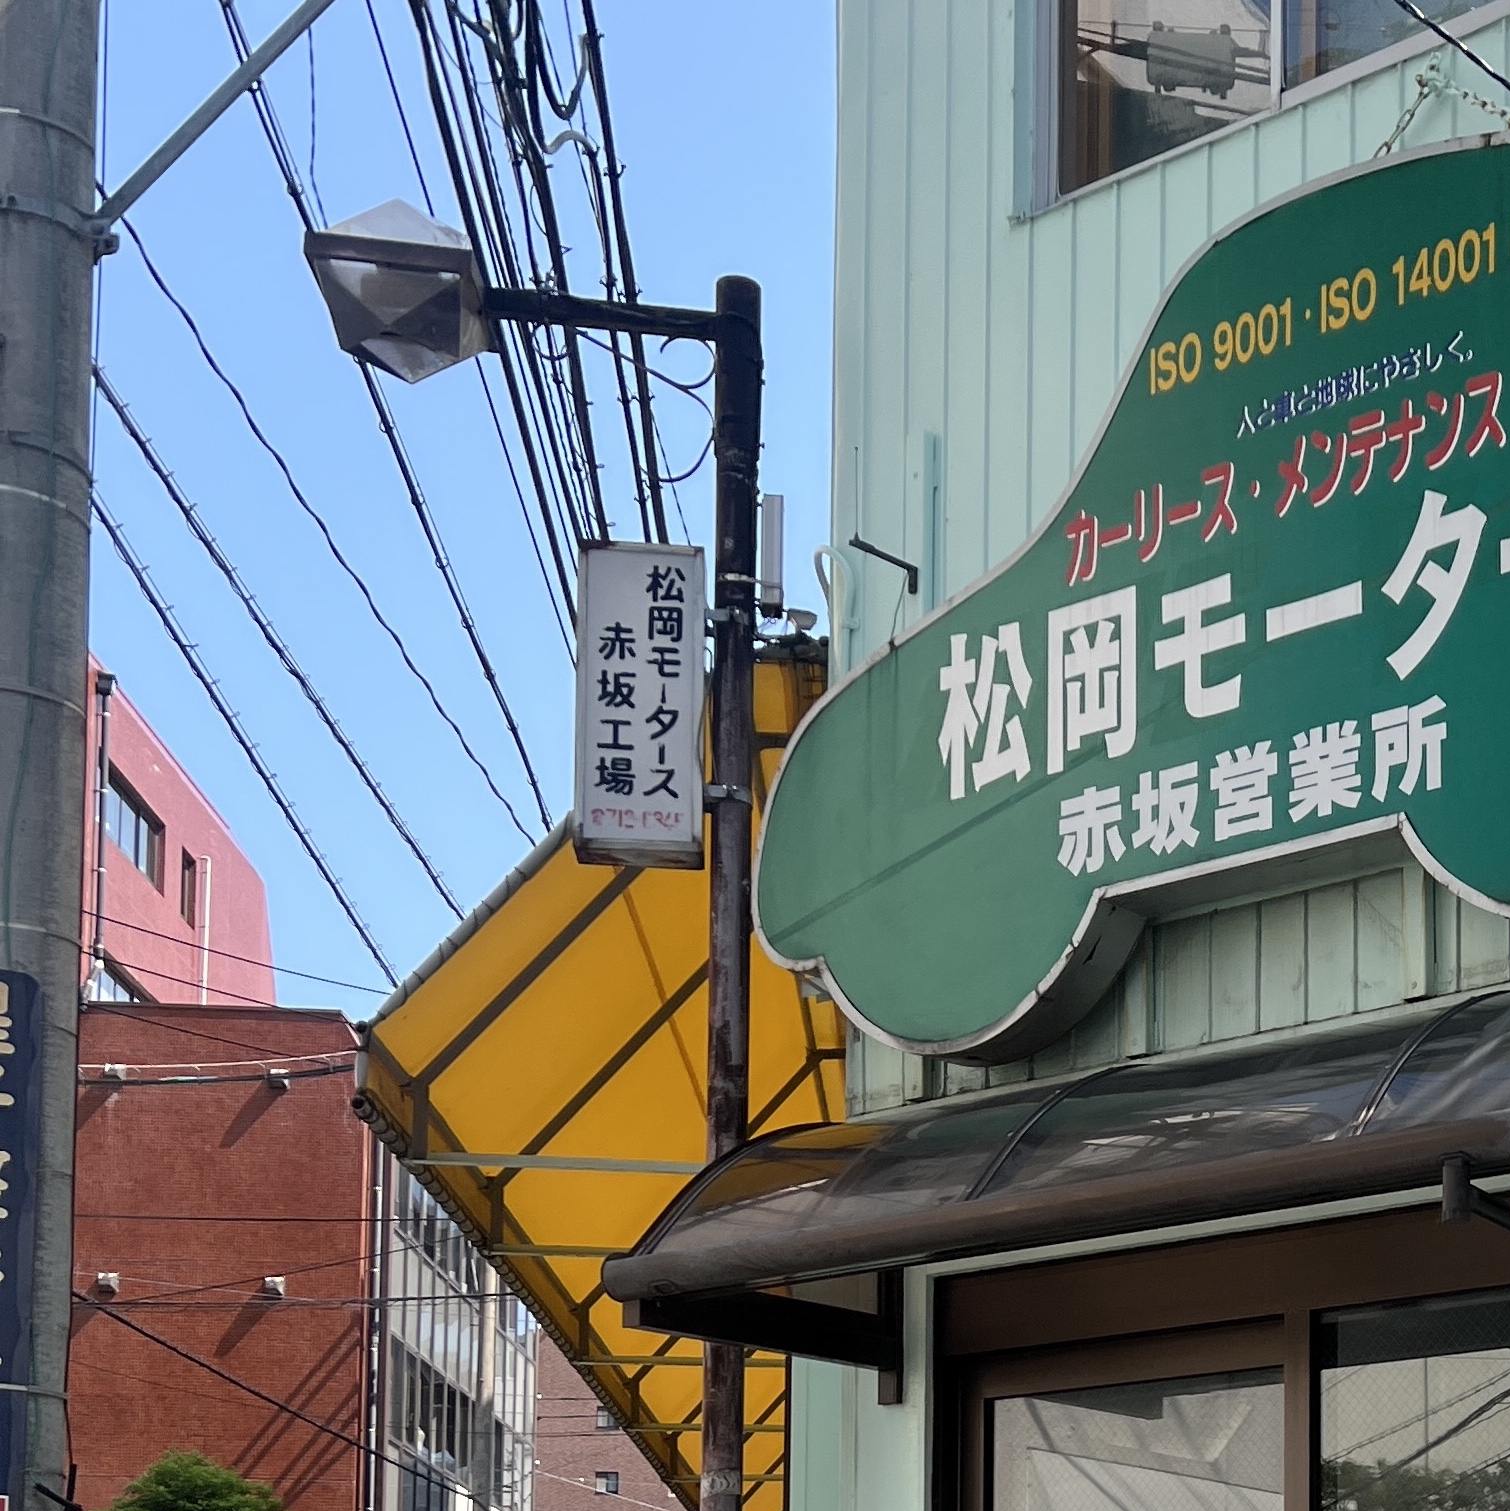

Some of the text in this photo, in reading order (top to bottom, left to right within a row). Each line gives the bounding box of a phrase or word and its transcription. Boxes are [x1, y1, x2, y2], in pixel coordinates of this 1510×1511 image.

[1149, 332, 1202, 395] ISO
[1213, 298, 1292, 371] 9001
[1320, 268, 1377, 333] ISO
[1392, 222, 1497, 306] 14001
[593, 621, 637, 796] 赤坂工場
[643, 564, 687, 799] 松岡モータース
[1055, 695, 1449, 877] 赤坂営業所
